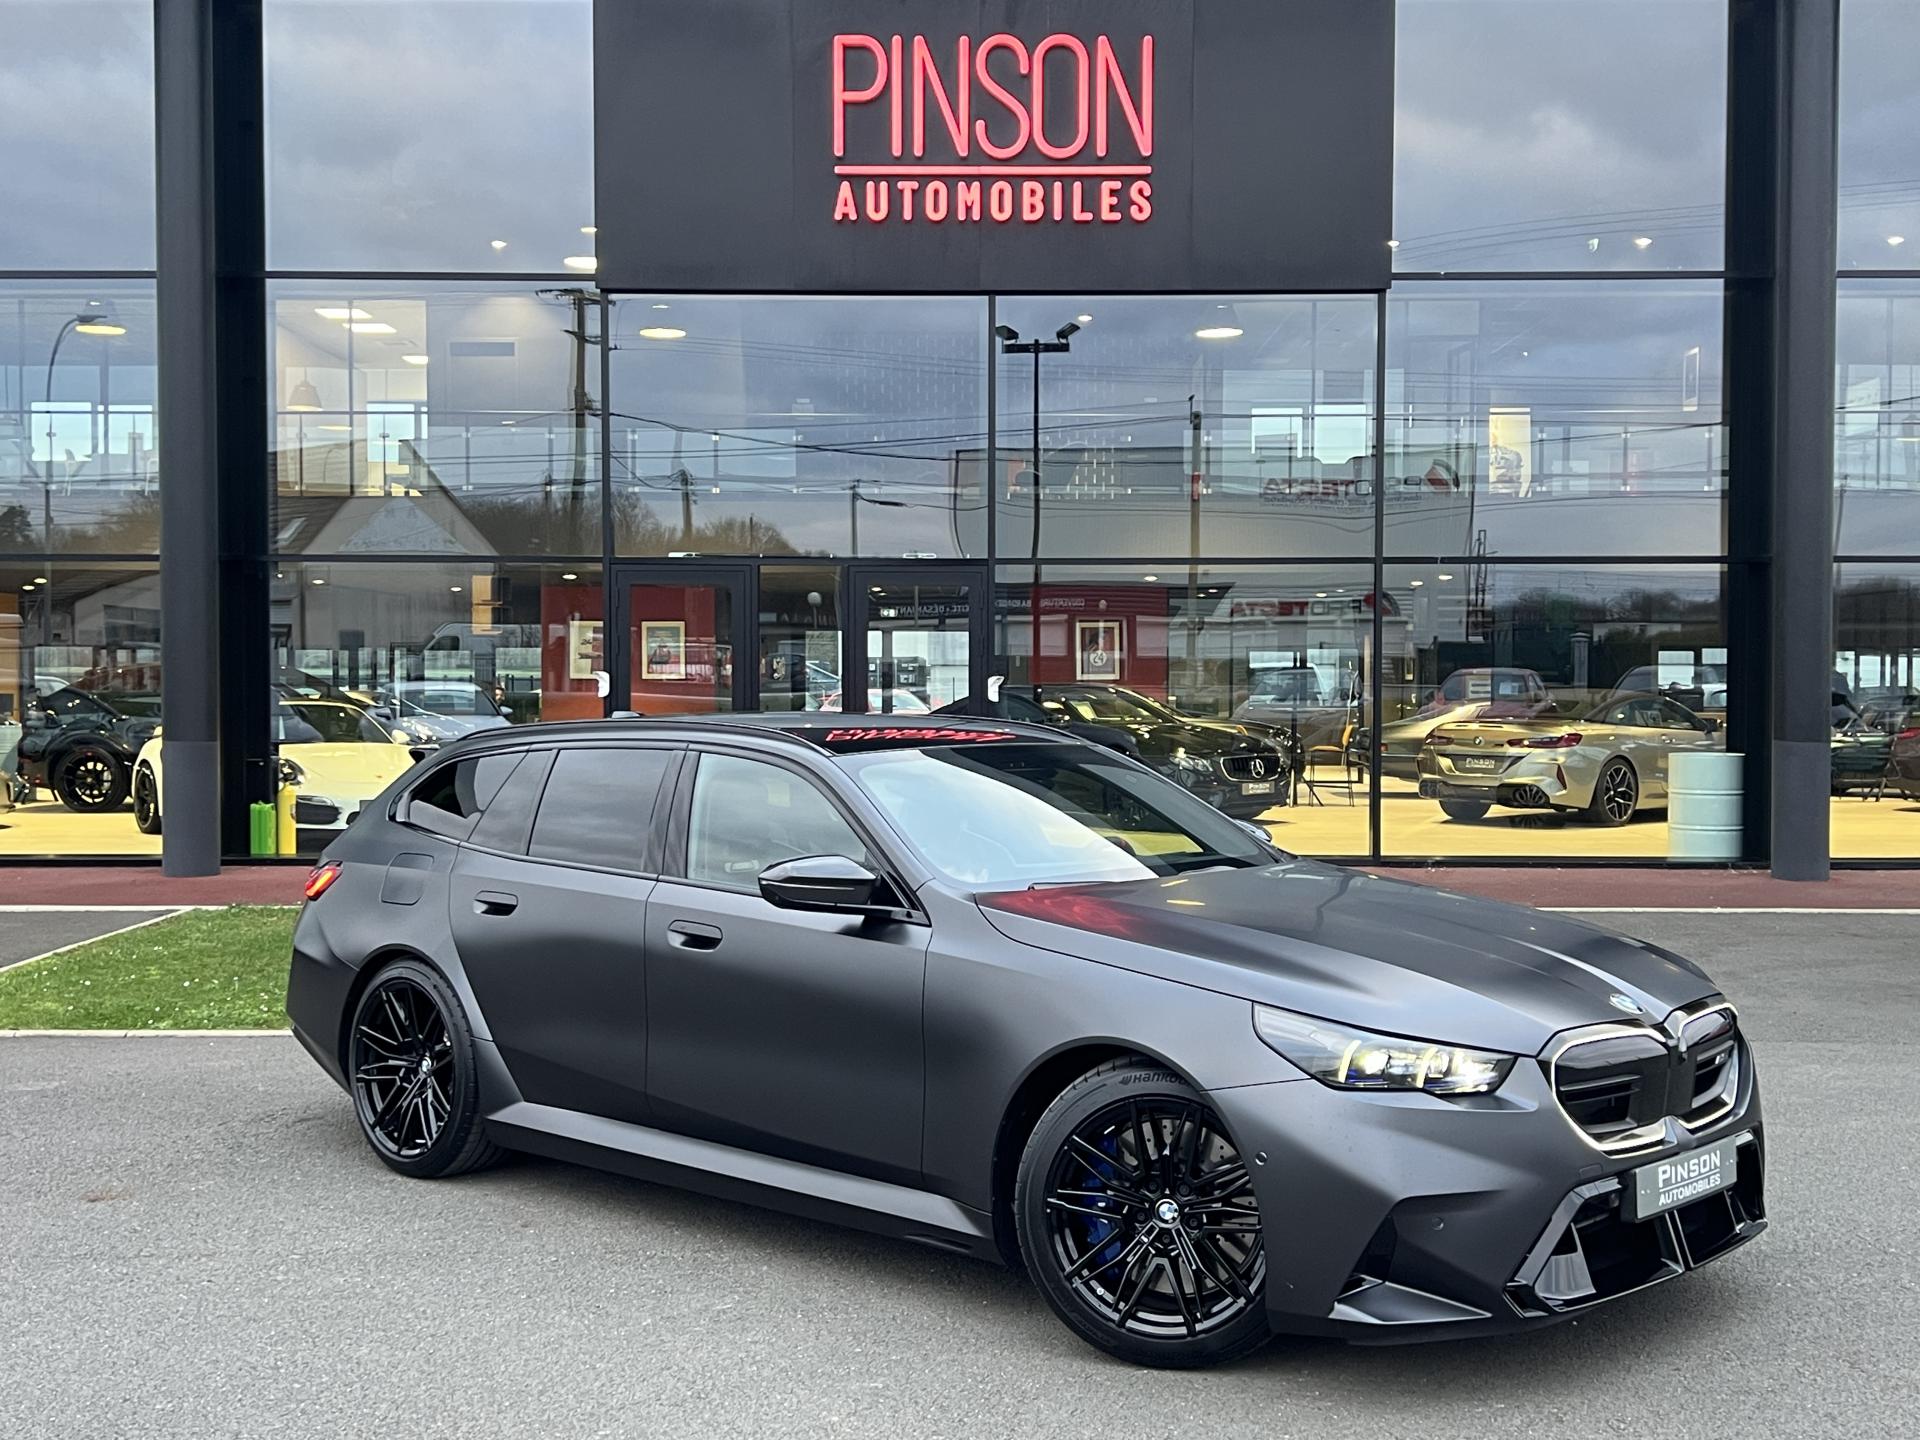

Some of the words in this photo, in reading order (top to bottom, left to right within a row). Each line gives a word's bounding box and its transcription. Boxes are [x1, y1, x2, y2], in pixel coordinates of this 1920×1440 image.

[832, 33, 1154, 160] PINSON
[833, 179, 1153, 222] AUTOMOBILES
[1132, 1071, 1189, 1086] Hankoo
[1658, 1150, 1721, 1188] PINSON
[1658, 1173, 1721, 1206] AUTOMOBILES
